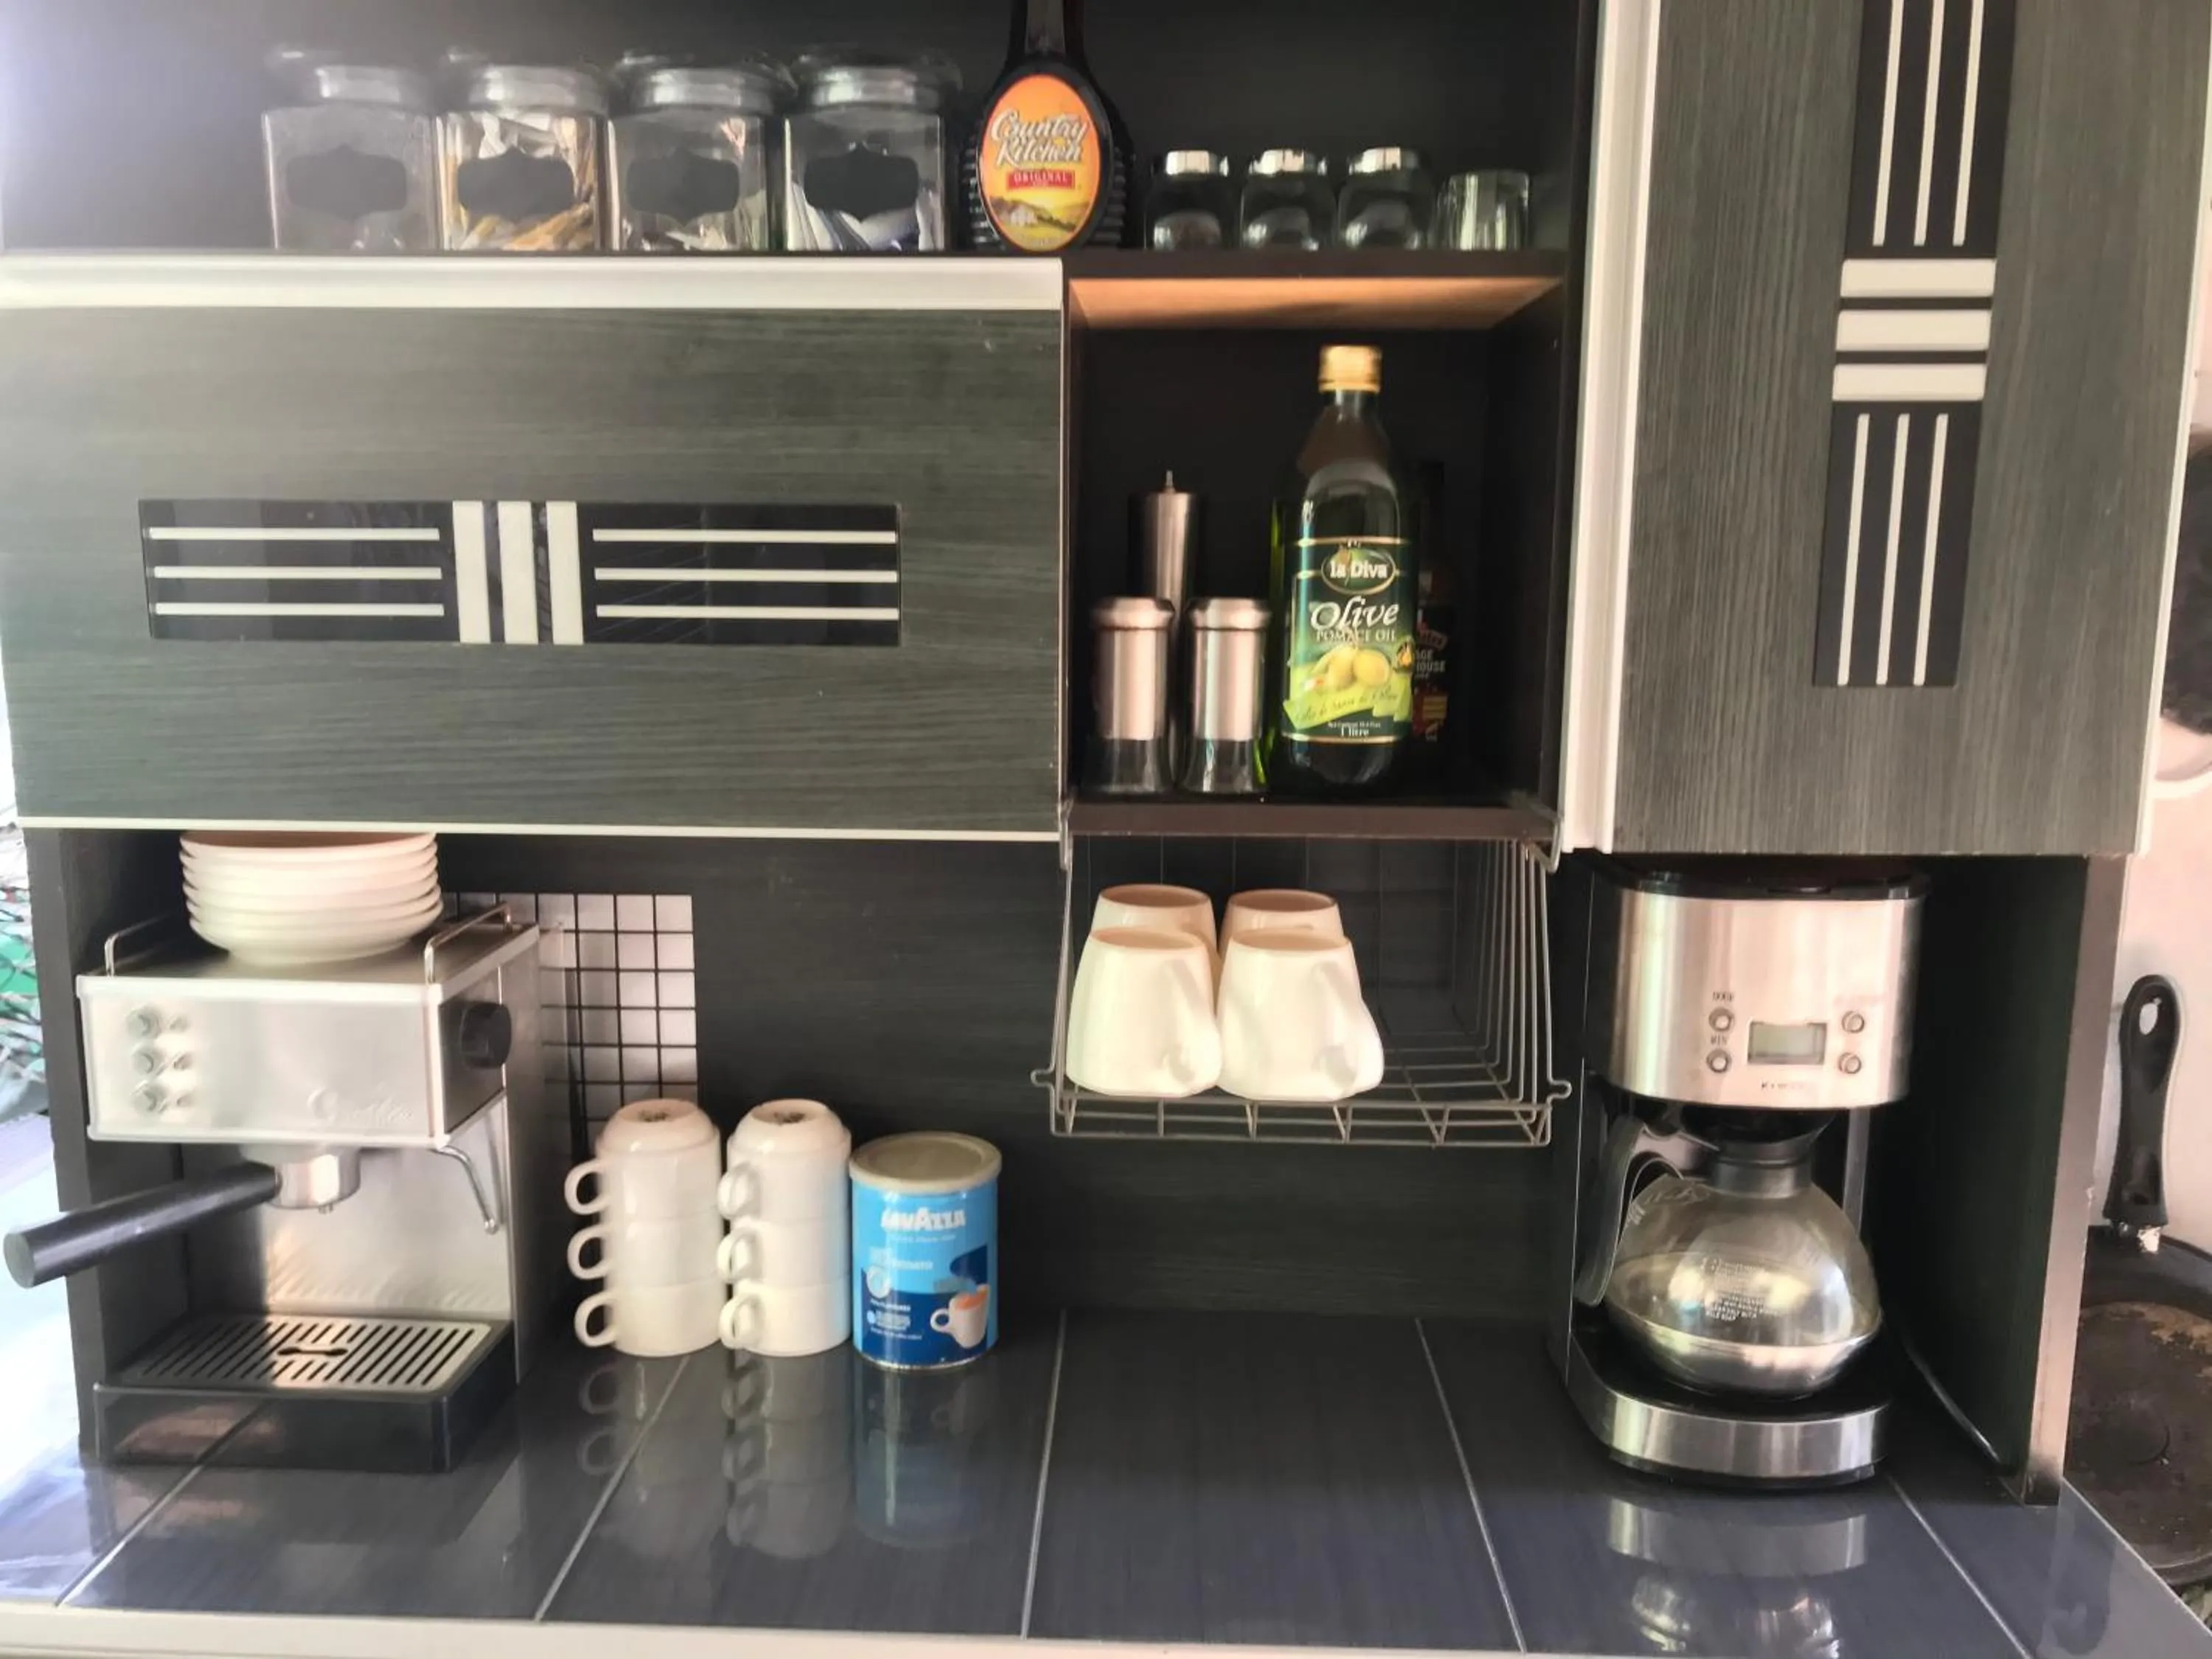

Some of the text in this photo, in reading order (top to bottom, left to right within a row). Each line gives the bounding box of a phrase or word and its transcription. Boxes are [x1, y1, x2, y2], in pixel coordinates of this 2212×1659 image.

[990, 110, 1088, 144] Country
[996, 136, 1081, 167] Kitchen
[1013, 170, 1068, 183] ORIGINAL
[1310, 596, 1399, 630] Olive
